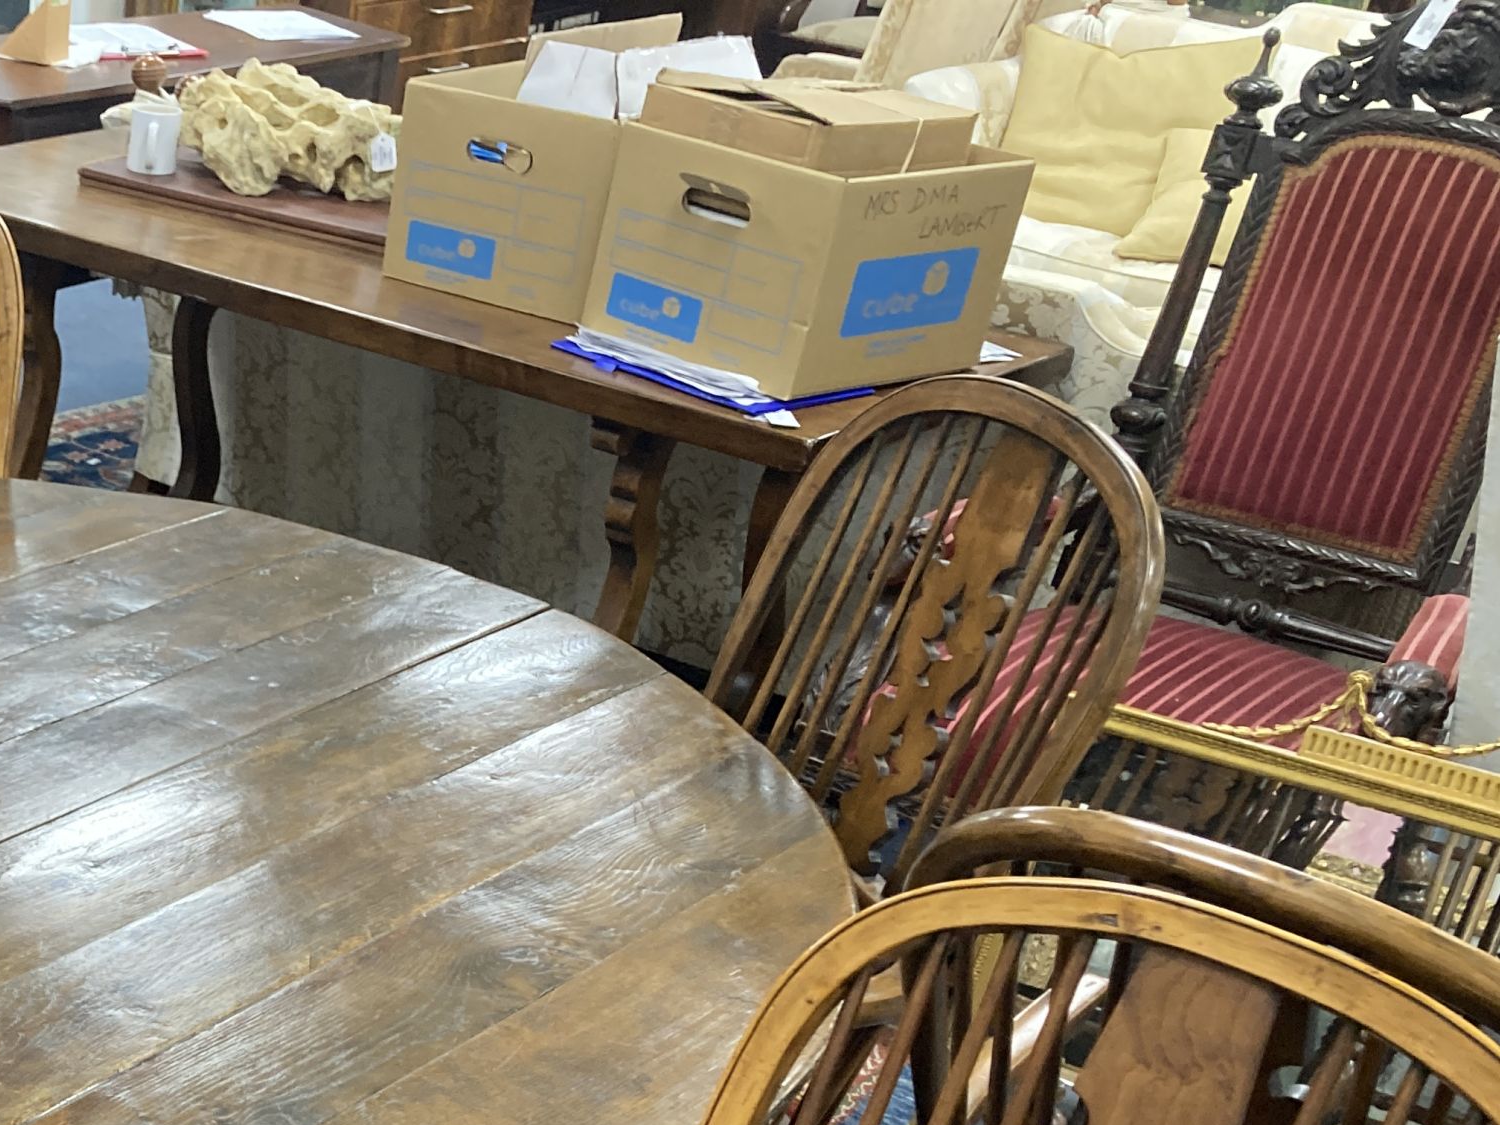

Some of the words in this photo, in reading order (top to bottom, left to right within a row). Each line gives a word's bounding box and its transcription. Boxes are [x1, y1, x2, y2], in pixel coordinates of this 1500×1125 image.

[864, 189, 900, 220] MRS
[618, 297, 660, 322] cube
[861, 291, 918, 318] cube
